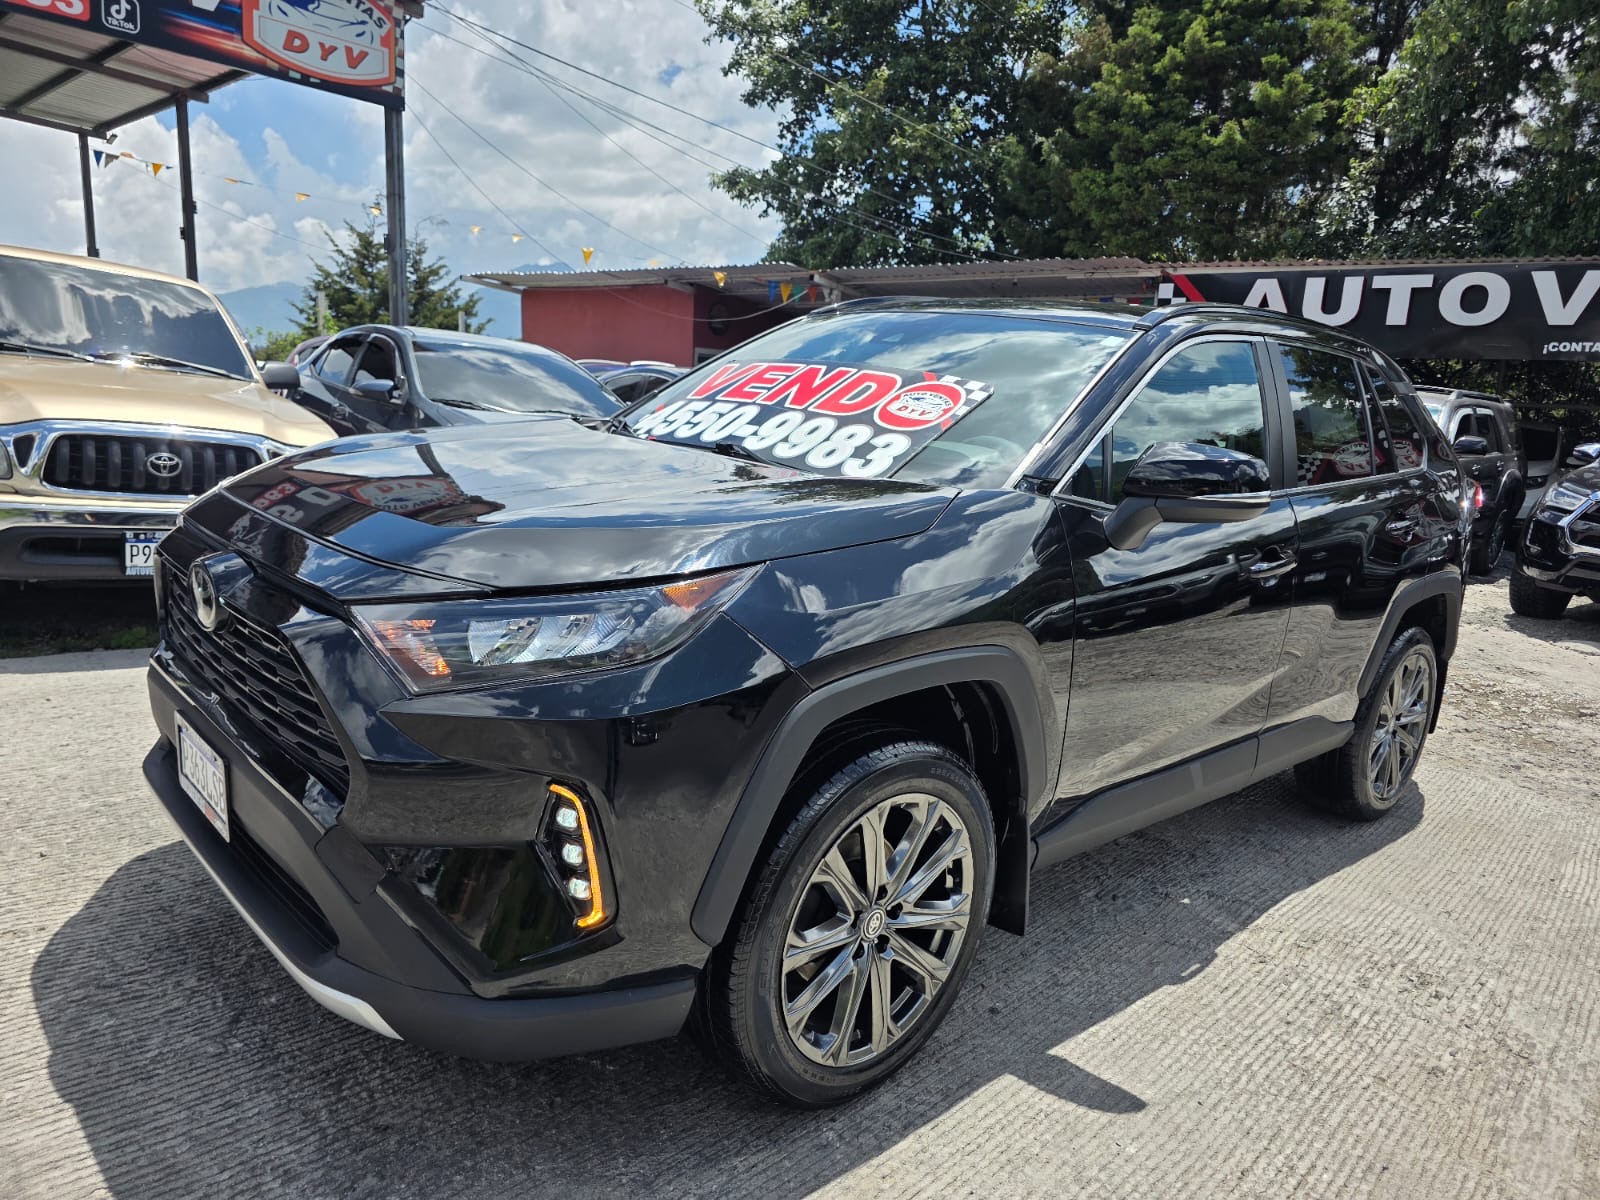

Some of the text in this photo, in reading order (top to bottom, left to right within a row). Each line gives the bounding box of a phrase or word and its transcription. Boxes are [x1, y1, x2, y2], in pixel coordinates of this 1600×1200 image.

[107, 17, 135, 30] TikTok
[1243, 271, 1511, 326] AUTO
[633, 400, 911, 478] 4550-9983
